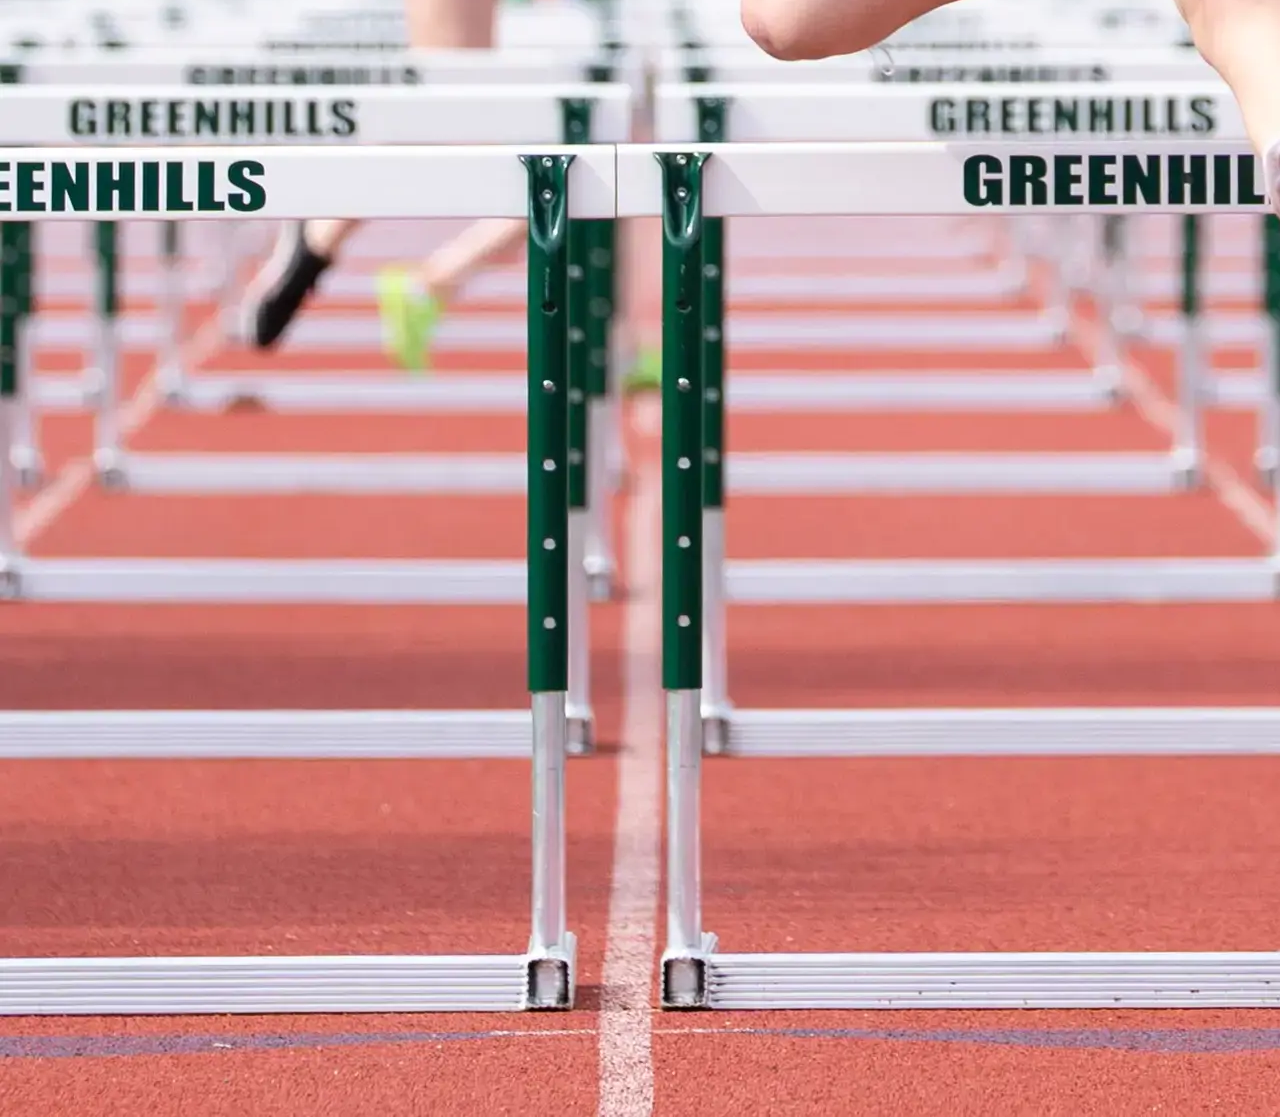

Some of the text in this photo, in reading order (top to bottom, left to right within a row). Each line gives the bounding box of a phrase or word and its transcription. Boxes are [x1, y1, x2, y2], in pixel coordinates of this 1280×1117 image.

[69, 98, 358, 138] GREENHILLS
[929, 95, 1217, 135] GREENHILLS
[962, 153, 1270, 207] GREENHIL
